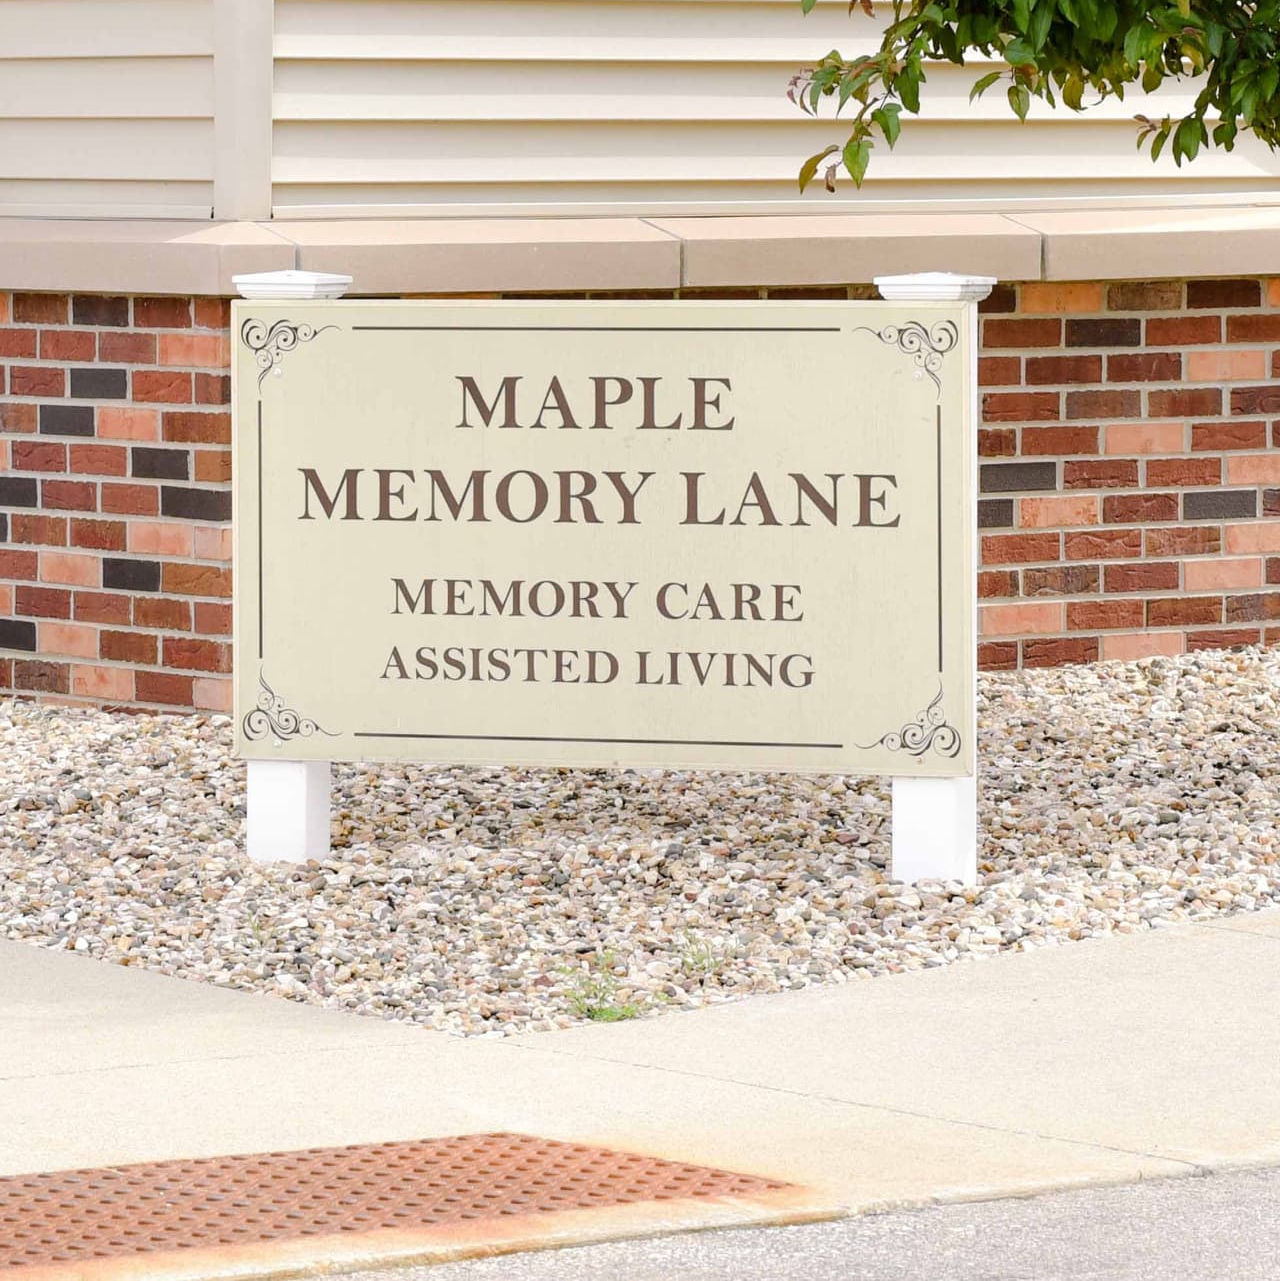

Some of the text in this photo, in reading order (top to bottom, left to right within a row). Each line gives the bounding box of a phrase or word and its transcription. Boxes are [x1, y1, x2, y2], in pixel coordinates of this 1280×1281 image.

[456, 375, 736, 431] MAPLE
[297, 467, 901, 528] MEMORY LANE
[390, 578, 804, 622] MEMORY CARE
[379, 645, 815, 688] ASSISTED LIVING
